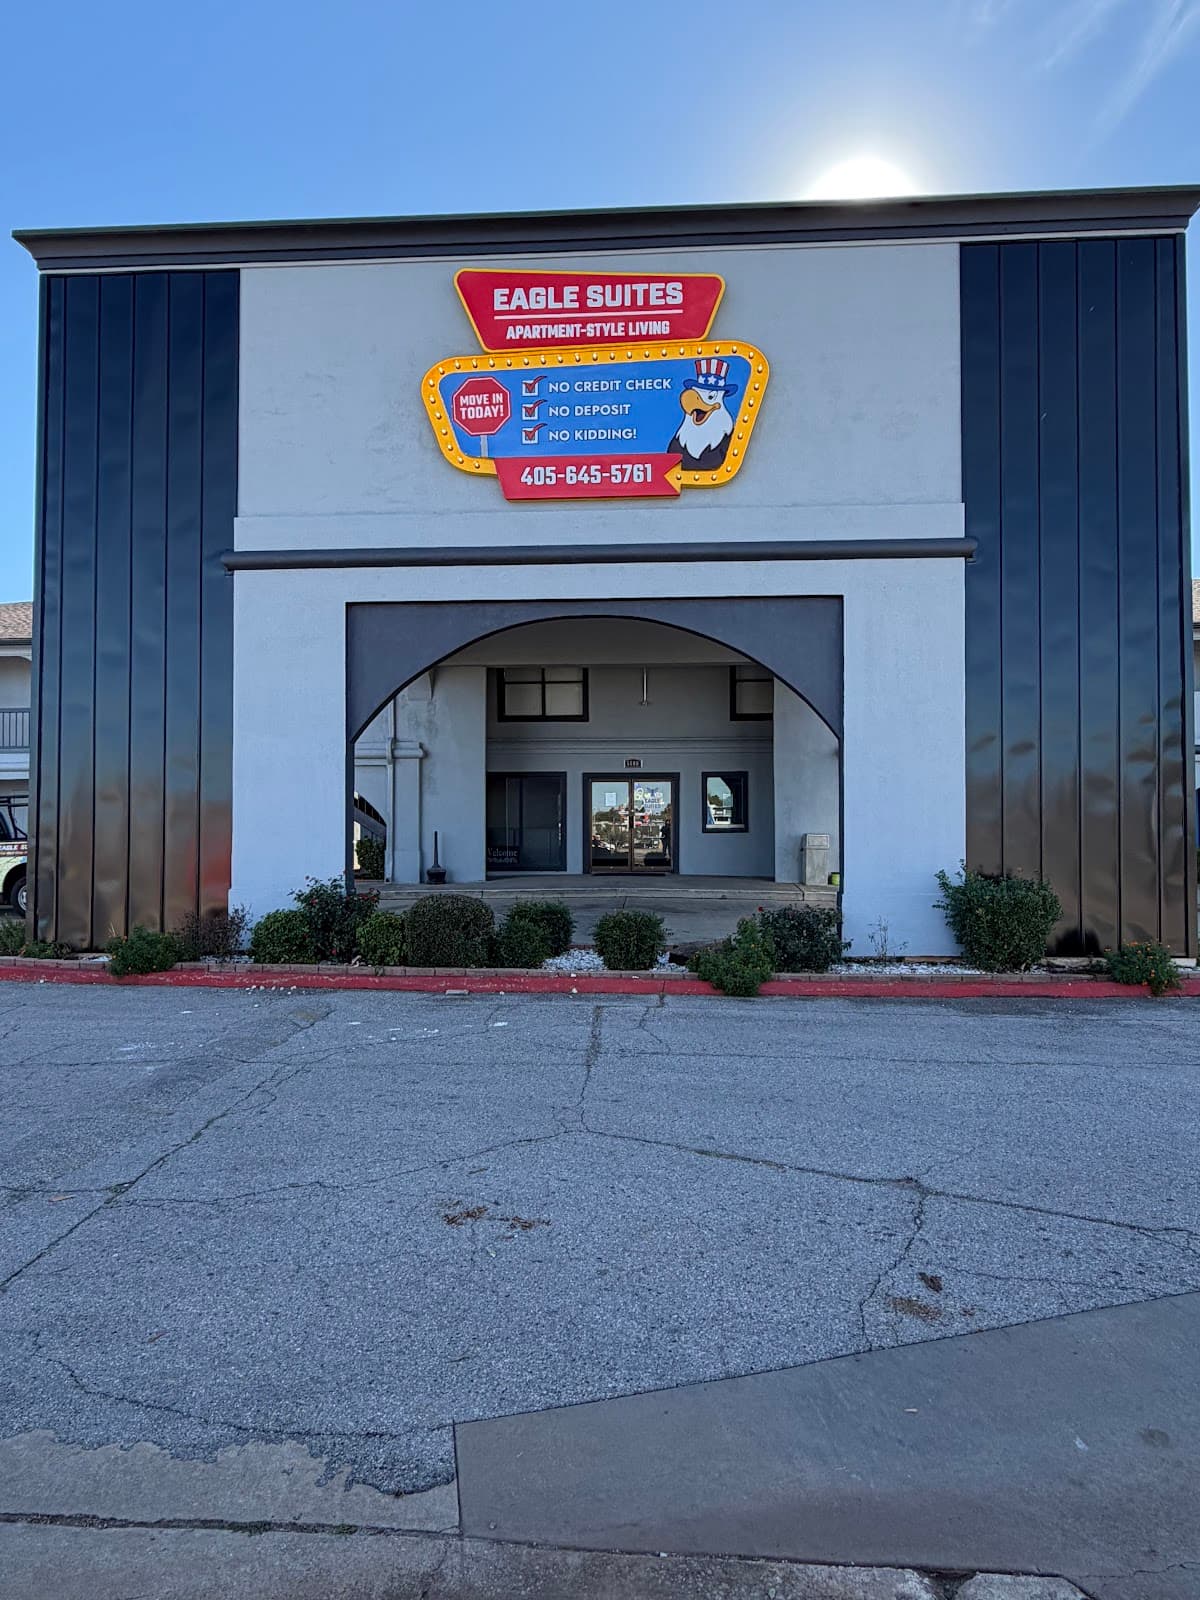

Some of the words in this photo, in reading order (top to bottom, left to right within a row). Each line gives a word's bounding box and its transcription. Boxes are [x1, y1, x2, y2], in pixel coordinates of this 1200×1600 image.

[493, 286, 579, 311] EAGLE
[586, 282, 683, 308] SUITES
[506, 323, 624, 340] APARTMENT-STYLE
[628, 320, 670, 335] LIVING
[548, 382, 570, 393] NO
[574, 380, 621, 392] CREDIT
[626, 378, 671, 390] CHECK
[459, 394, 489, 405] MOVE
[493, 393, 503, 404] IN
[459, 405, 504, 420] TODAY!
[548, 406, 570, 417] NO
[574, 404, 631, 416] DEPOSIT
[548, 430, 570, 441] NO
[574, 428, 637, 441] KIDDING!
[520, 463, 652, 486] 405-645-5761
